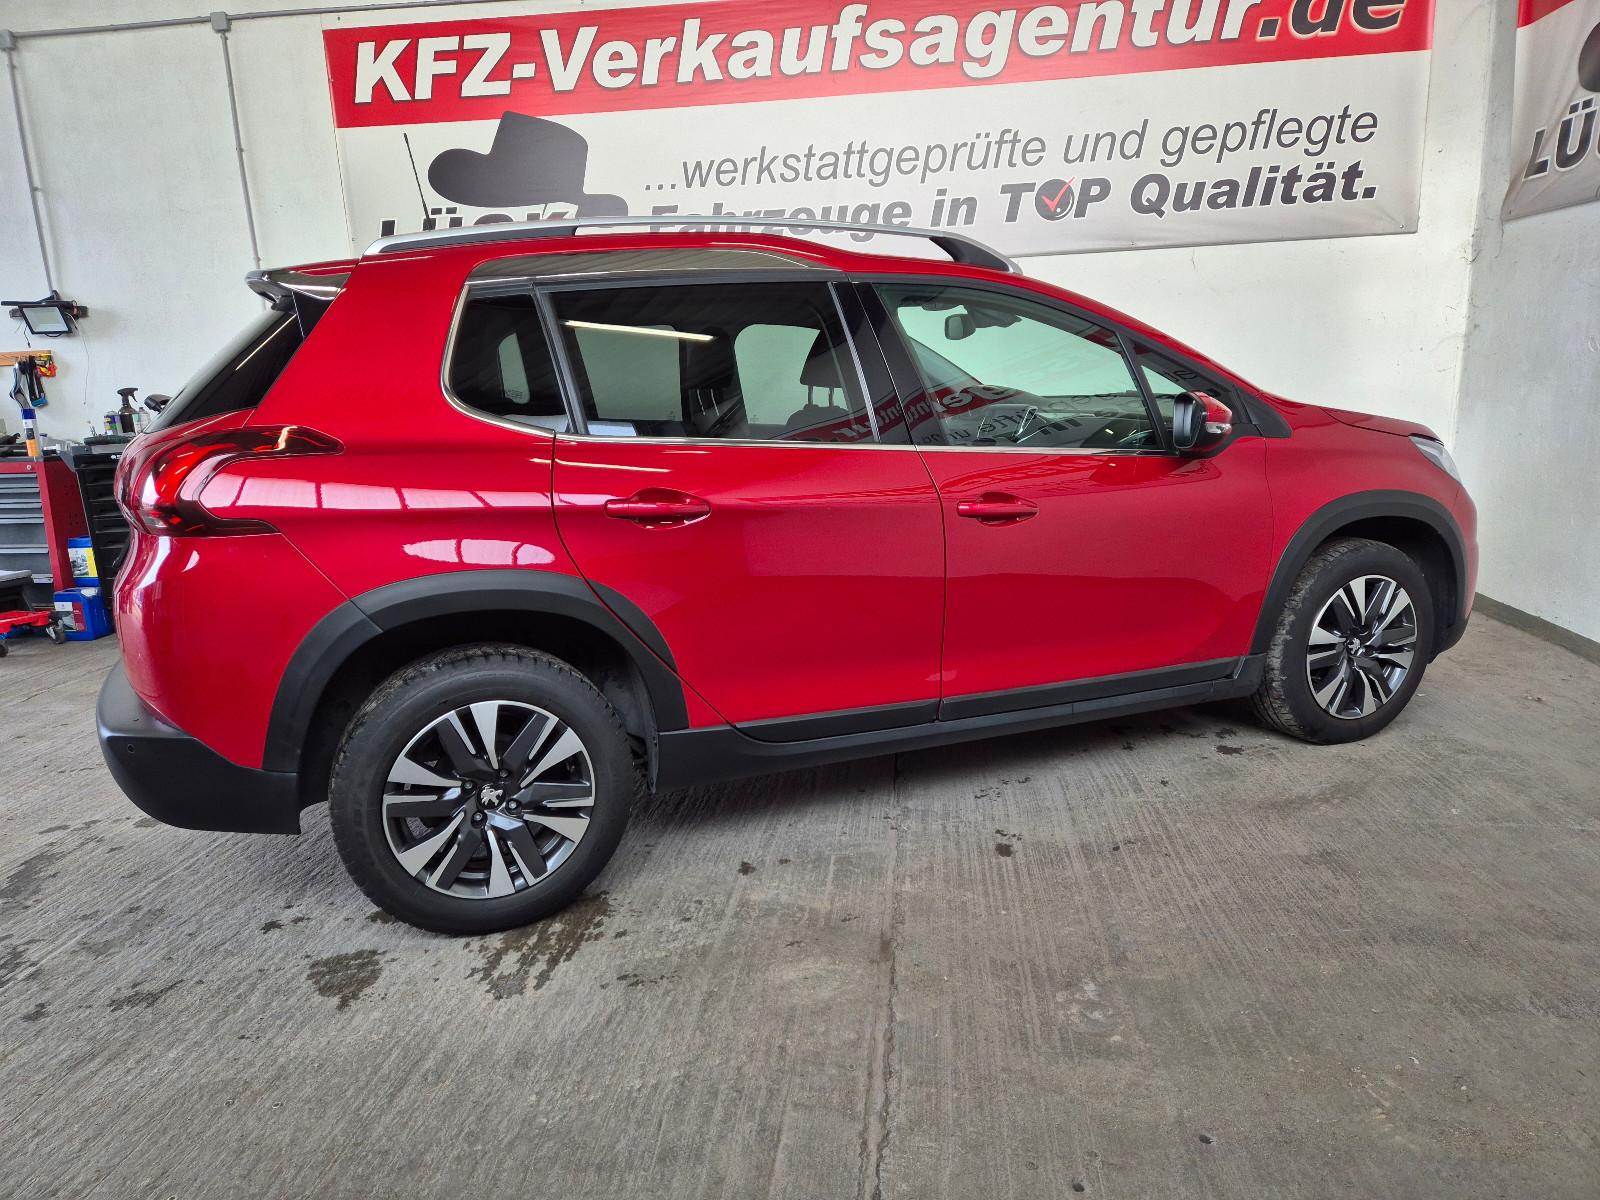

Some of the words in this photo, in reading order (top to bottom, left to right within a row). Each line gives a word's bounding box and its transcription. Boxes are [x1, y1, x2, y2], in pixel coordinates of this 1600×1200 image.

[645, 128, 1046, 190] ...werkstattgeprüfte
[1063, 118, 1149, 164] und
[1160, 105, 1378, 167] gepflegte
[1522, 95, 1600, 181] LÜ
[649, 200, 912, 241] Fhrzeuge
[930, 187, 978, 228] in
[1000, 177, 1112, 222] TOP
[1130, 160, 1377, 218] Qualität.
